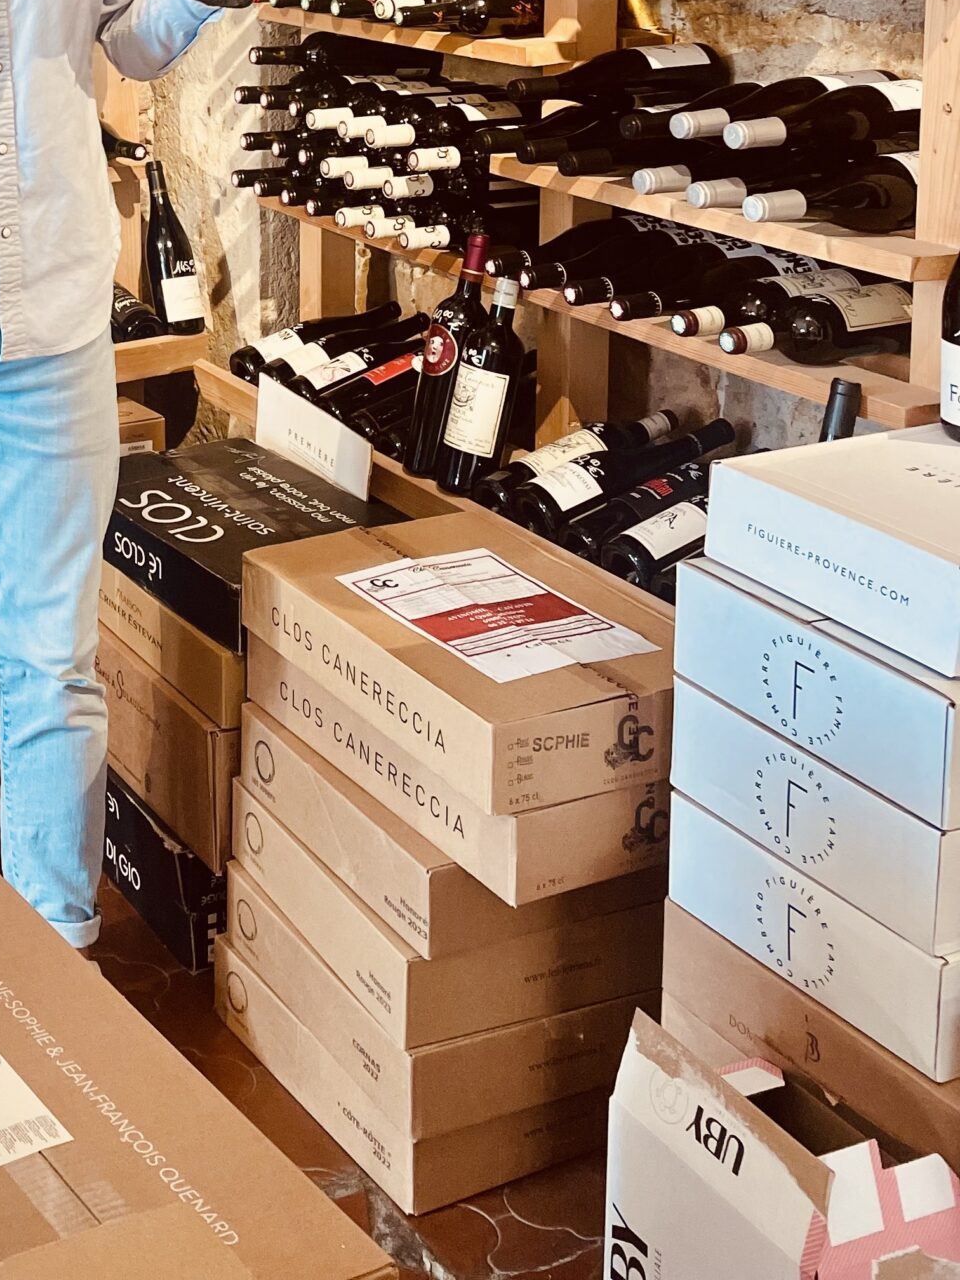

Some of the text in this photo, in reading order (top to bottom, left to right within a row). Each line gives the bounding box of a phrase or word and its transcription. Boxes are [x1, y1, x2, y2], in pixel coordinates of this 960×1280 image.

[270, 604, 314, 653] CLOS
[321, 643, 448, 755] CANERECCIA
[807, 694, 843, 746] FAMILLE
[279, 680, 467, 840] CLOS CANERECCIA
[801, 815, 838, 865] FAMILLE
[803, 942, 836, 989] FAMILLE
[352, 1038, 381, 1073] CORNAS
[44, 1045, 63, 1060] &
[55, 1055, 166, 1168] JEAN-FRANÇOIS
[158, 1166, 240, 1246] QUENARD
[685, 1104, 745, 1176] UBY
[609, 1202, 649, 1280] BY
